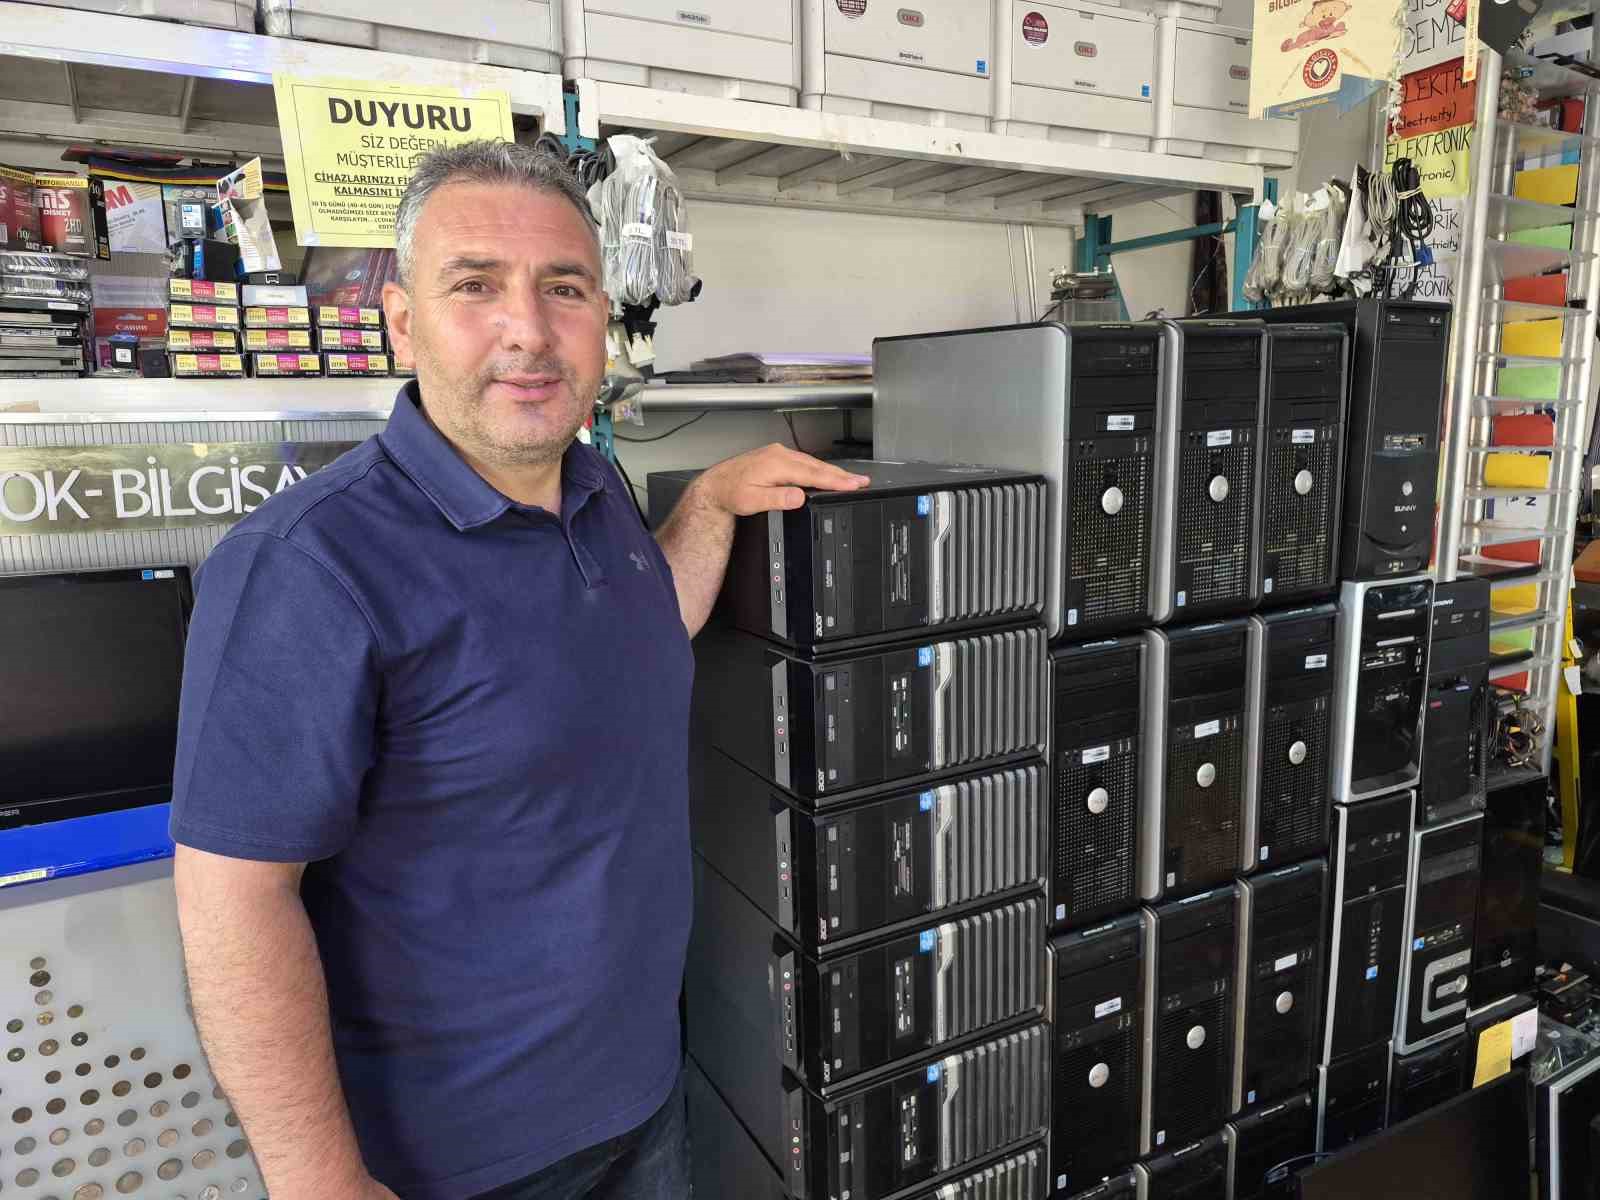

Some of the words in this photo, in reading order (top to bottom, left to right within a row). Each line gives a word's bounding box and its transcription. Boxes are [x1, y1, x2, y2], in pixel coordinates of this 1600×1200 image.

[328, 97, 472, 132] DUYURU
[361, 133, 385, 149] SİZ
[336, 151, 419, 169] MÜŞTERİLE
[314, 170, 395, 185] CİHAZLARINIZI
[334, 186, 392, 197] KALMASINI
[0, 469, 103, 522] OK-
[112, 455, 312, 519] BİLGİSA
[1394, 505, 1417, 513] SUNNY
[815, 611, 823, 637] acer
